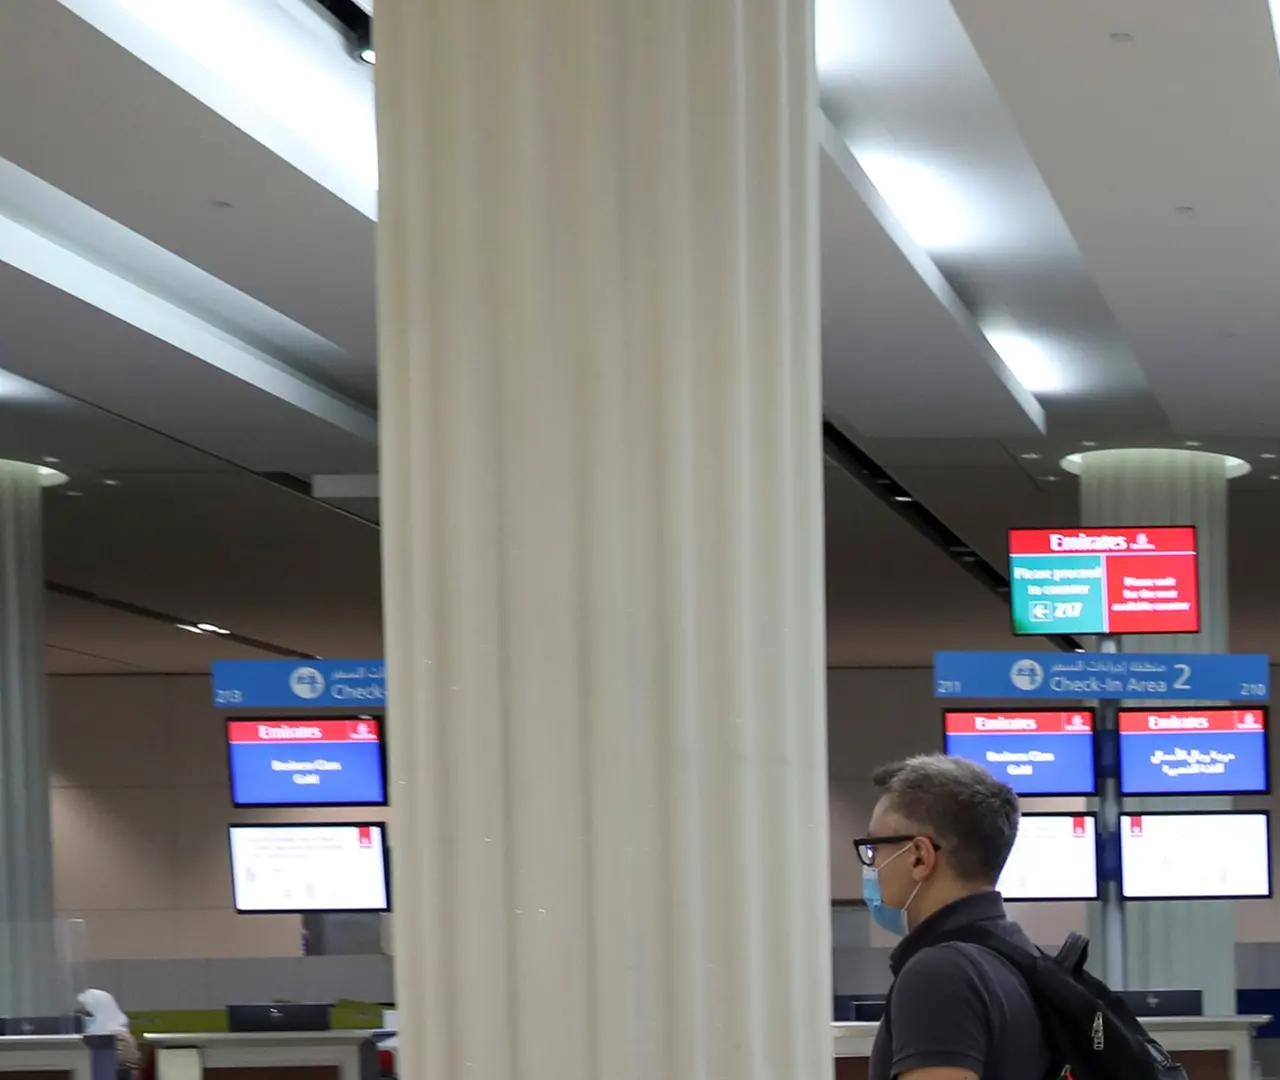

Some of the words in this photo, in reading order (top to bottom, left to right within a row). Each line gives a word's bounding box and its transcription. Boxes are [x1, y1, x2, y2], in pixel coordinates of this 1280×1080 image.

[1050, 533, 1128, 550] Emirates
[1173, 663, 1191, 690] 2
[330, 684, 387, 699] Check-
[1049, 677, 1123, 692] Check-In
[1125, 678, 1167, 692] Area
[975, 715, 1037, 730] Emirates
[1148, 714, 1209, 729] Emirates
[257, 725, 322, 739] Emirates
